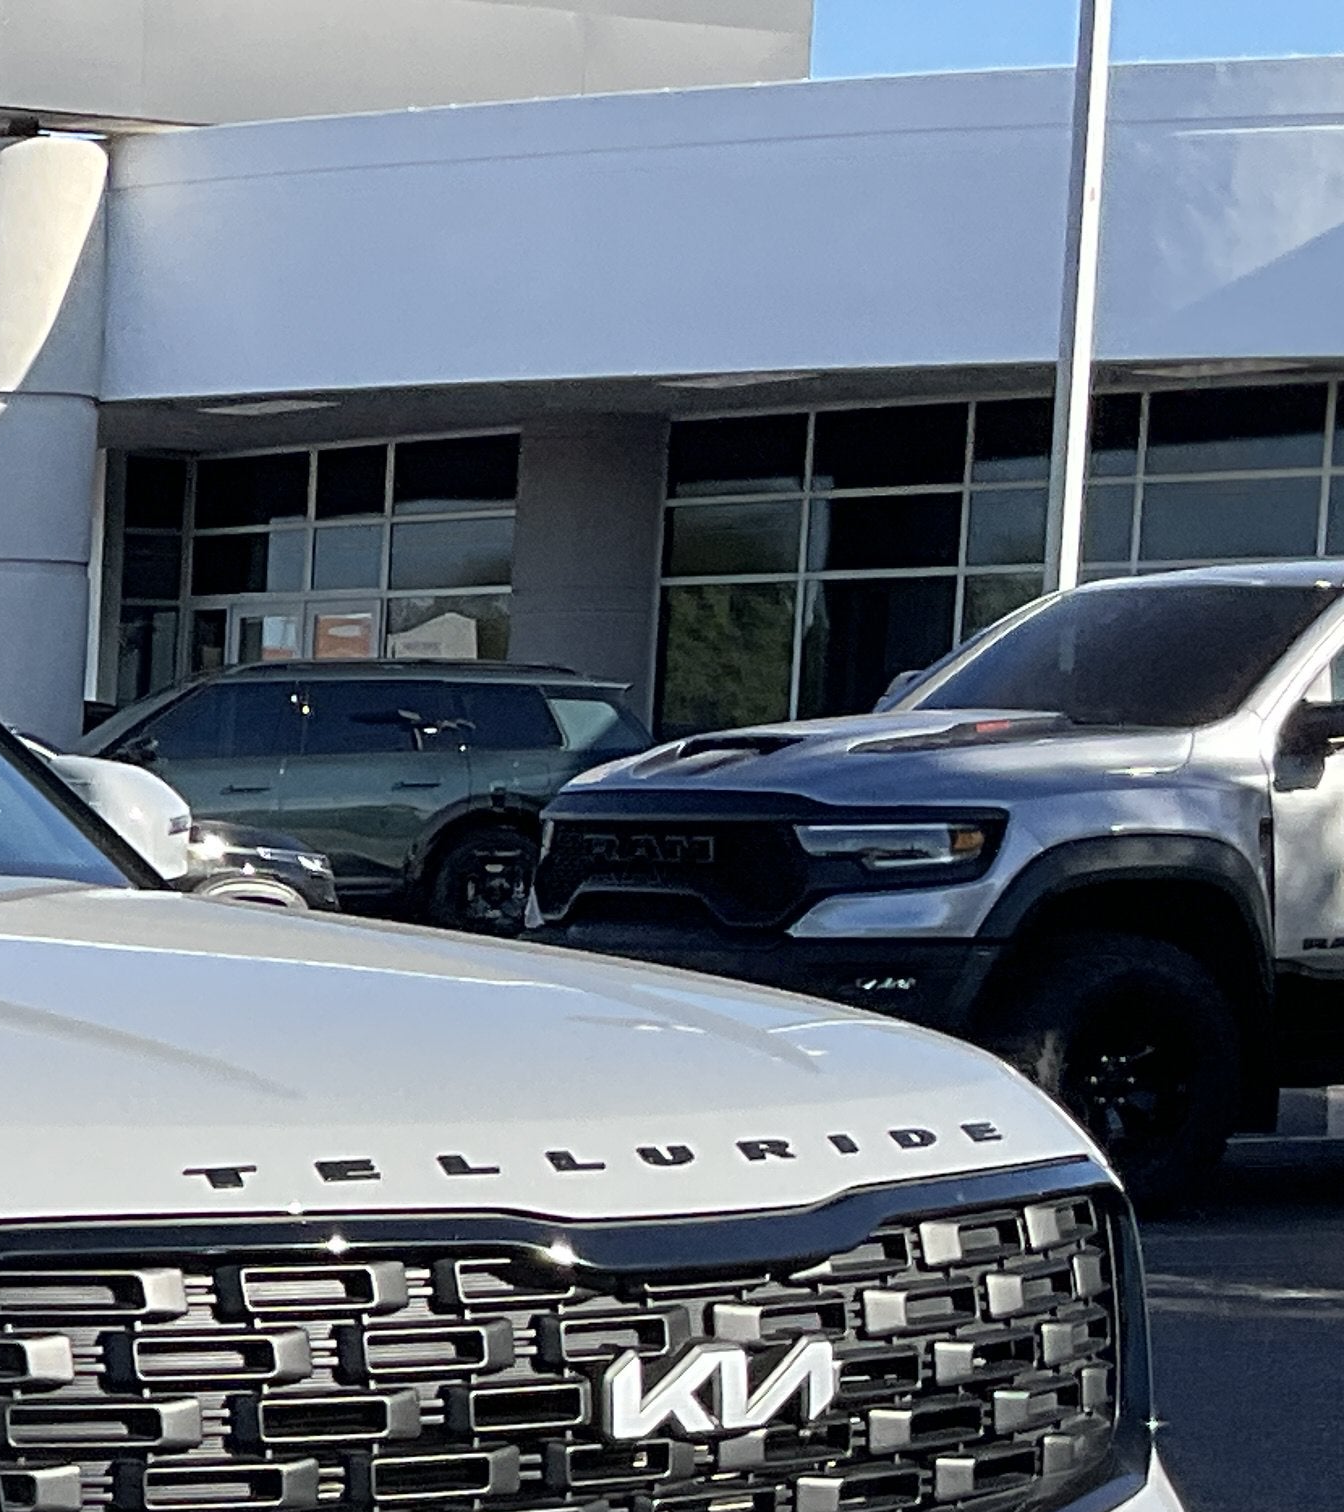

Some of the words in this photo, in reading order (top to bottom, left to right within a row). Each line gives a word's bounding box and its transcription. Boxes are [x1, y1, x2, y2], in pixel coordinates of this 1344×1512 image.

[582, 834, 715, 864] RAM
[182, 1122, 1002, 1189] TELLURIDE
[605, 1338, 836, 1440] KIA
